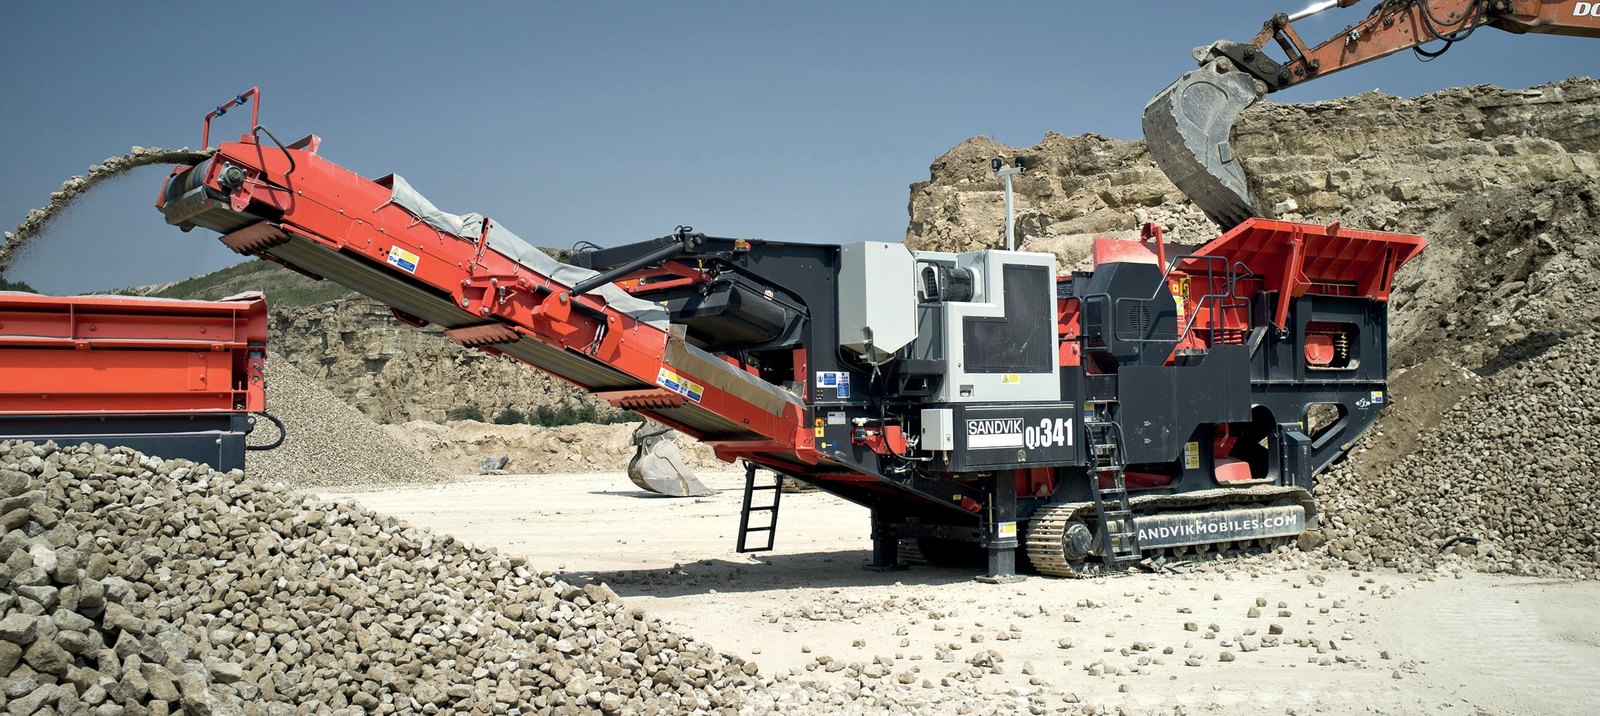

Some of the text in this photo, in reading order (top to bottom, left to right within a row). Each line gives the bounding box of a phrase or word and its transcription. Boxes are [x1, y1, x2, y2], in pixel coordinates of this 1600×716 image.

[968, 420, 1022, 434] SANDVIK
[1025, 418, 1073, 449] QJ341
[1137, 514, 1297, 541] ANDVIKMOBILES.COM
